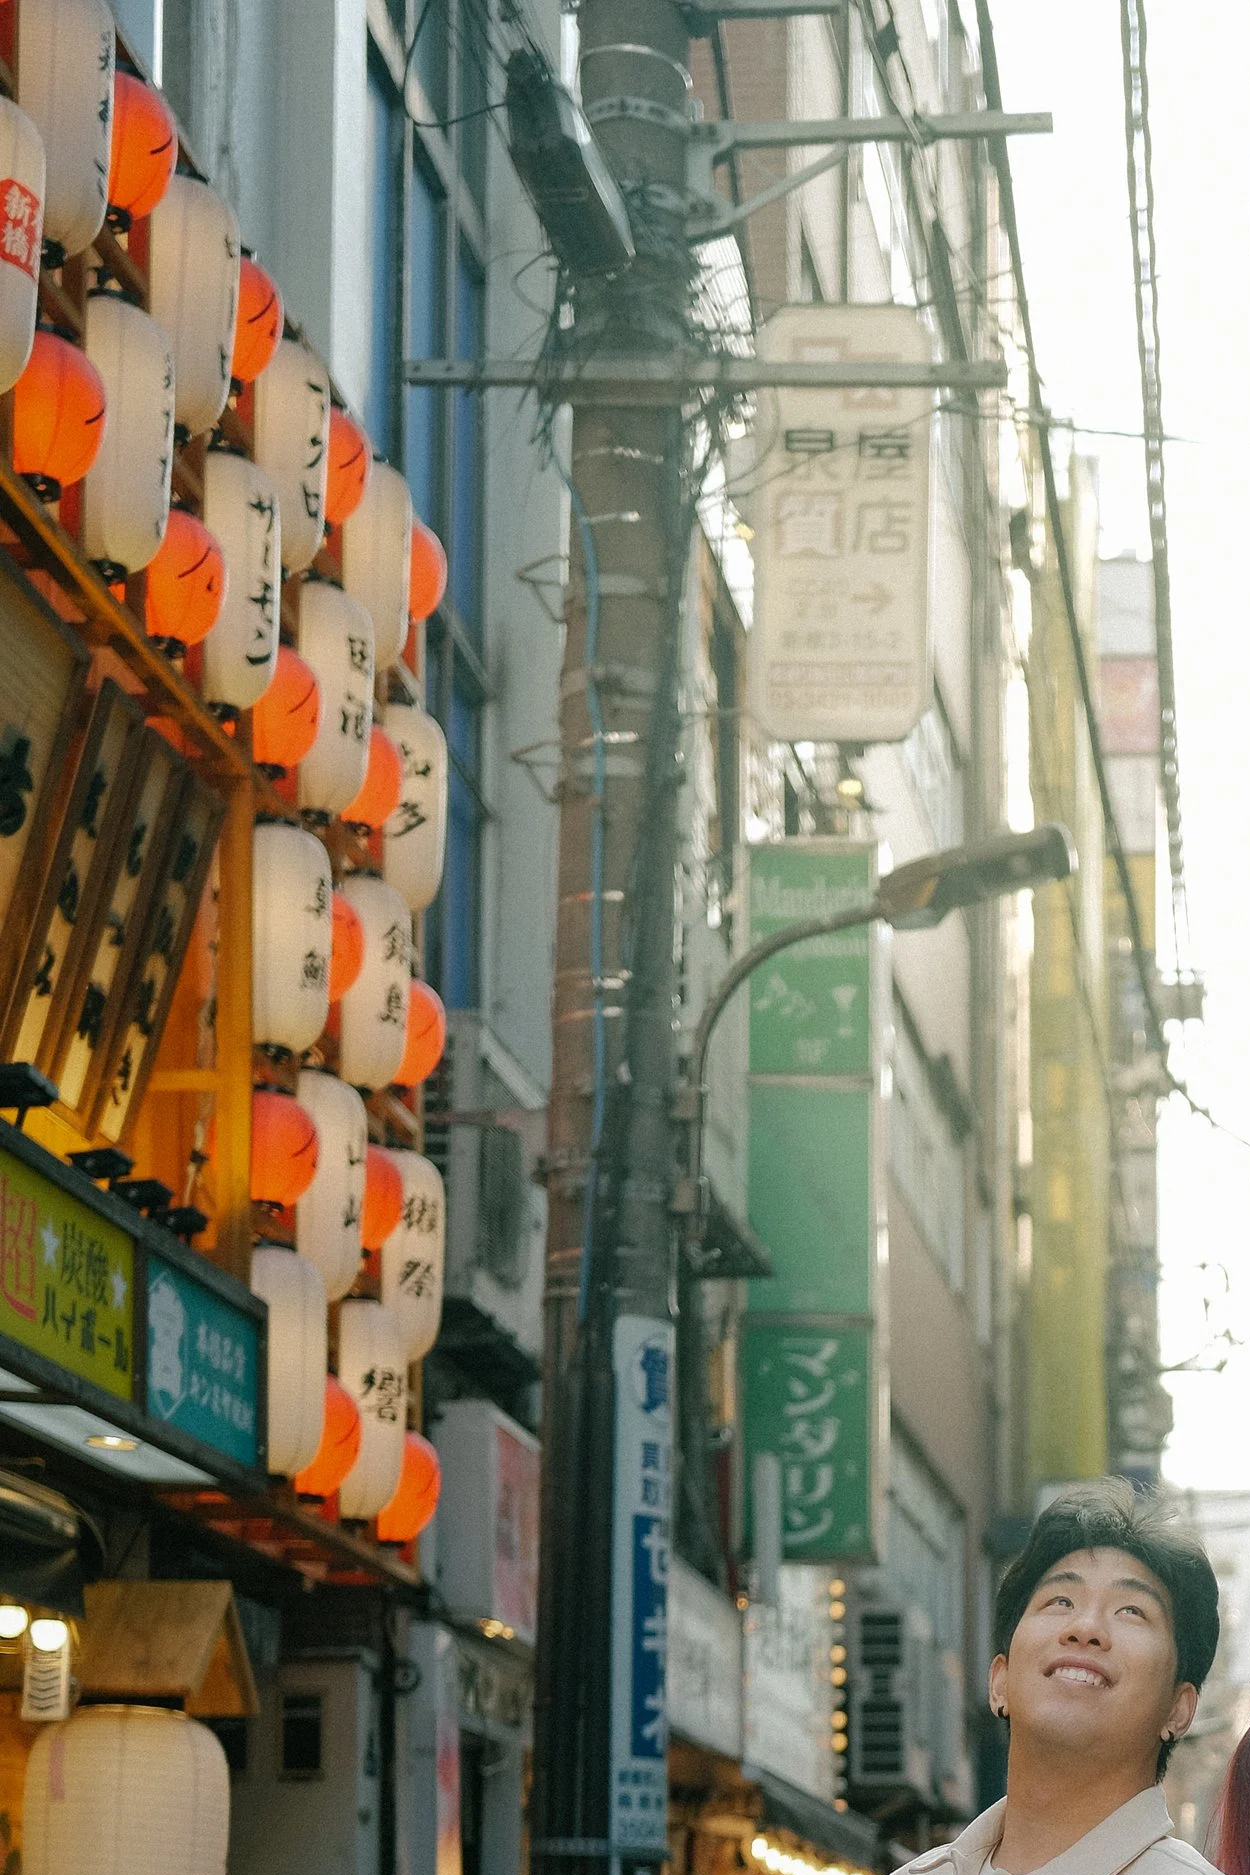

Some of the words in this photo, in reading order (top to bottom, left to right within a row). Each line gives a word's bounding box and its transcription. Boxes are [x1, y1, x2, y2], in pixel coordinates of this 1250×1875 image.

[42, 1282, 129, 1374] ハイボール
